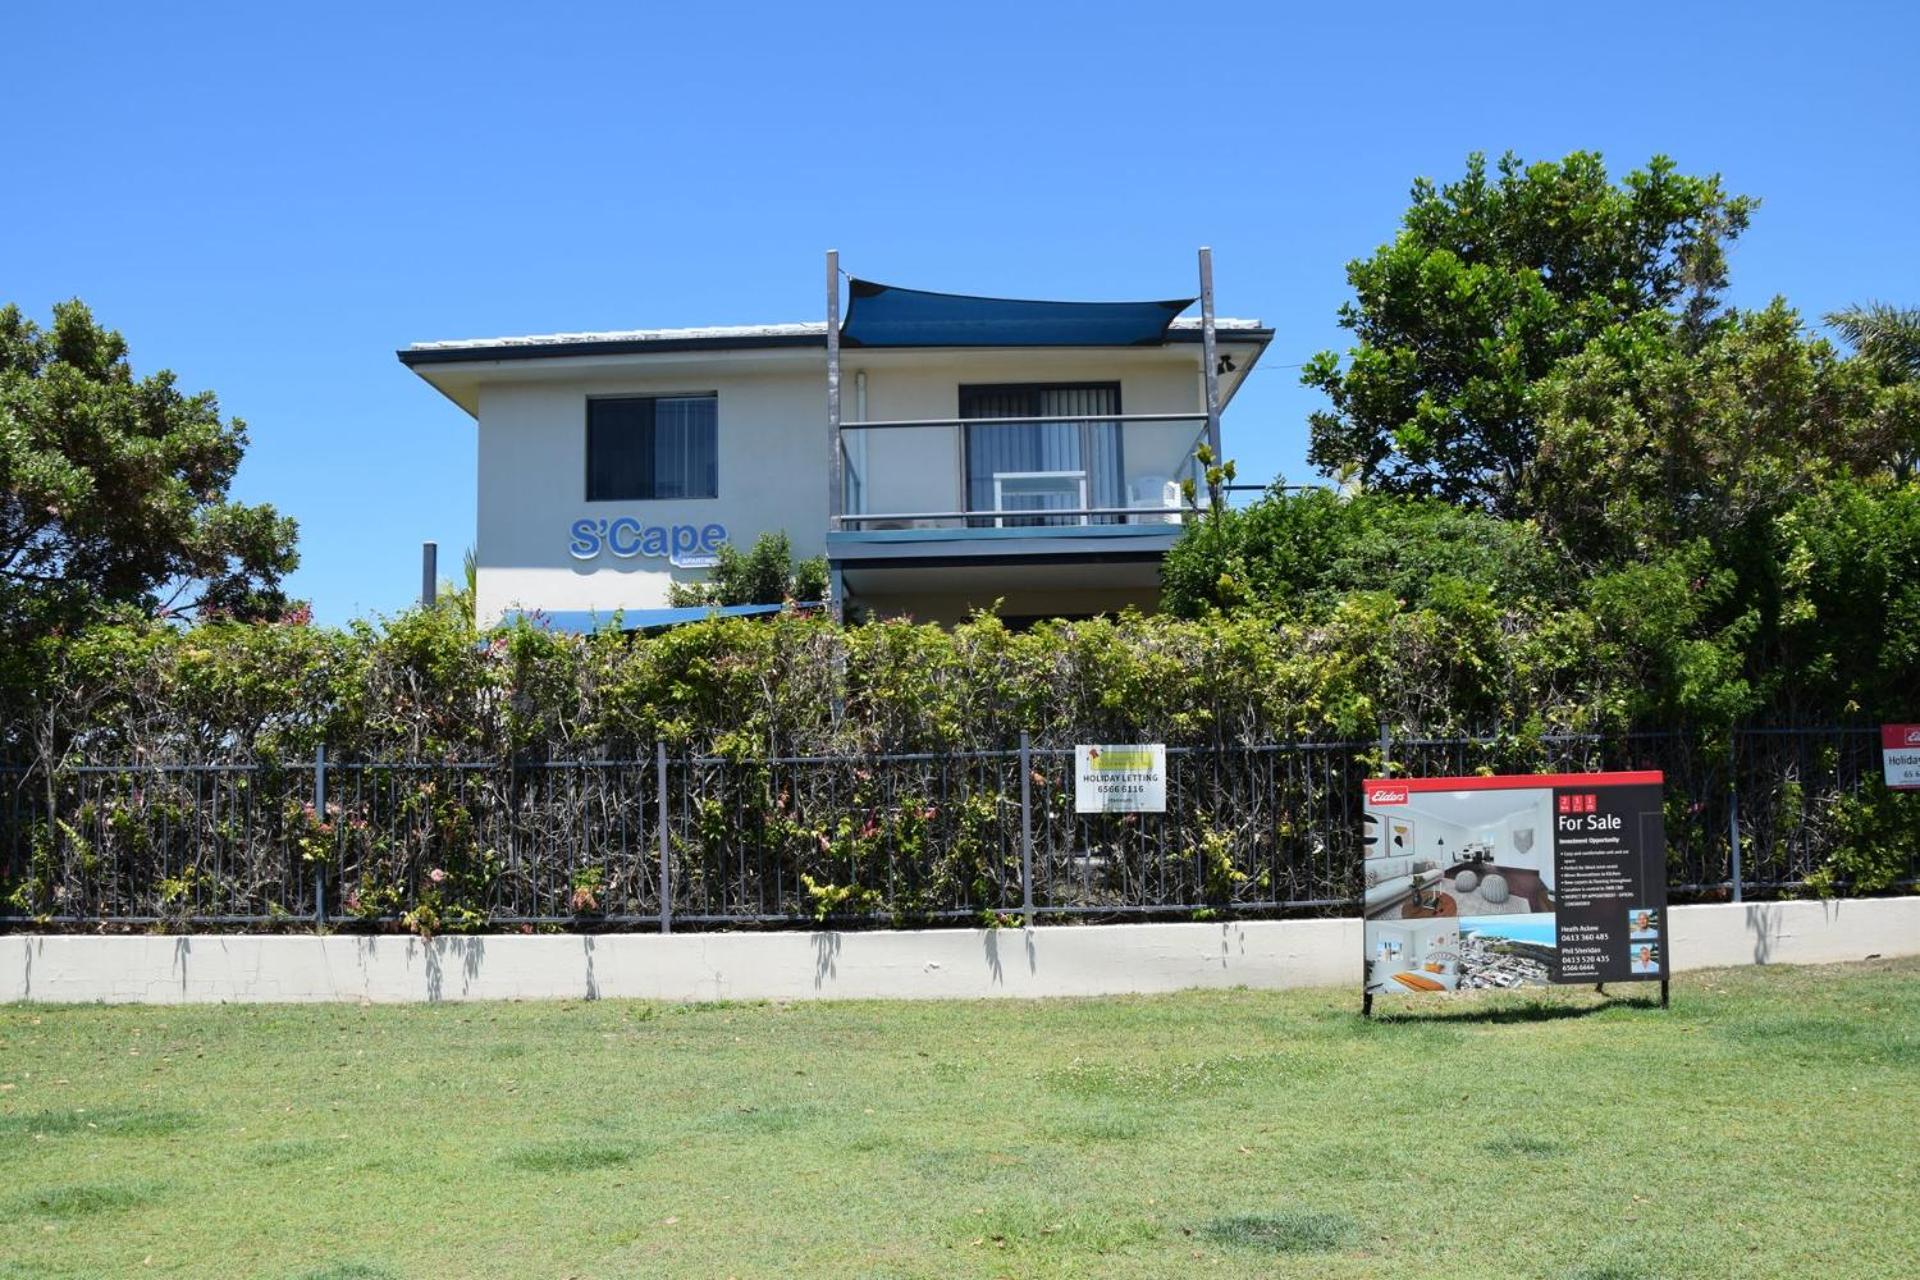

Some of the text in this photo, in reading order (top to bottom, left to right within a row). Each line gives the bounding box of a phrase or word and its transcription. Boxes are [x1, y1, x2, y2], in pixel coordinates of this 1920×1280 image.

[570, 516, 727, 559] S'Cape
[1083, 773, 1158, 783] HOLIDAY LETTING
[1371, 790, 1406, 802] Elders
[1558, 813, 1622, 831] For Sale
[1588, 836, 1620, 845] Opportunity
